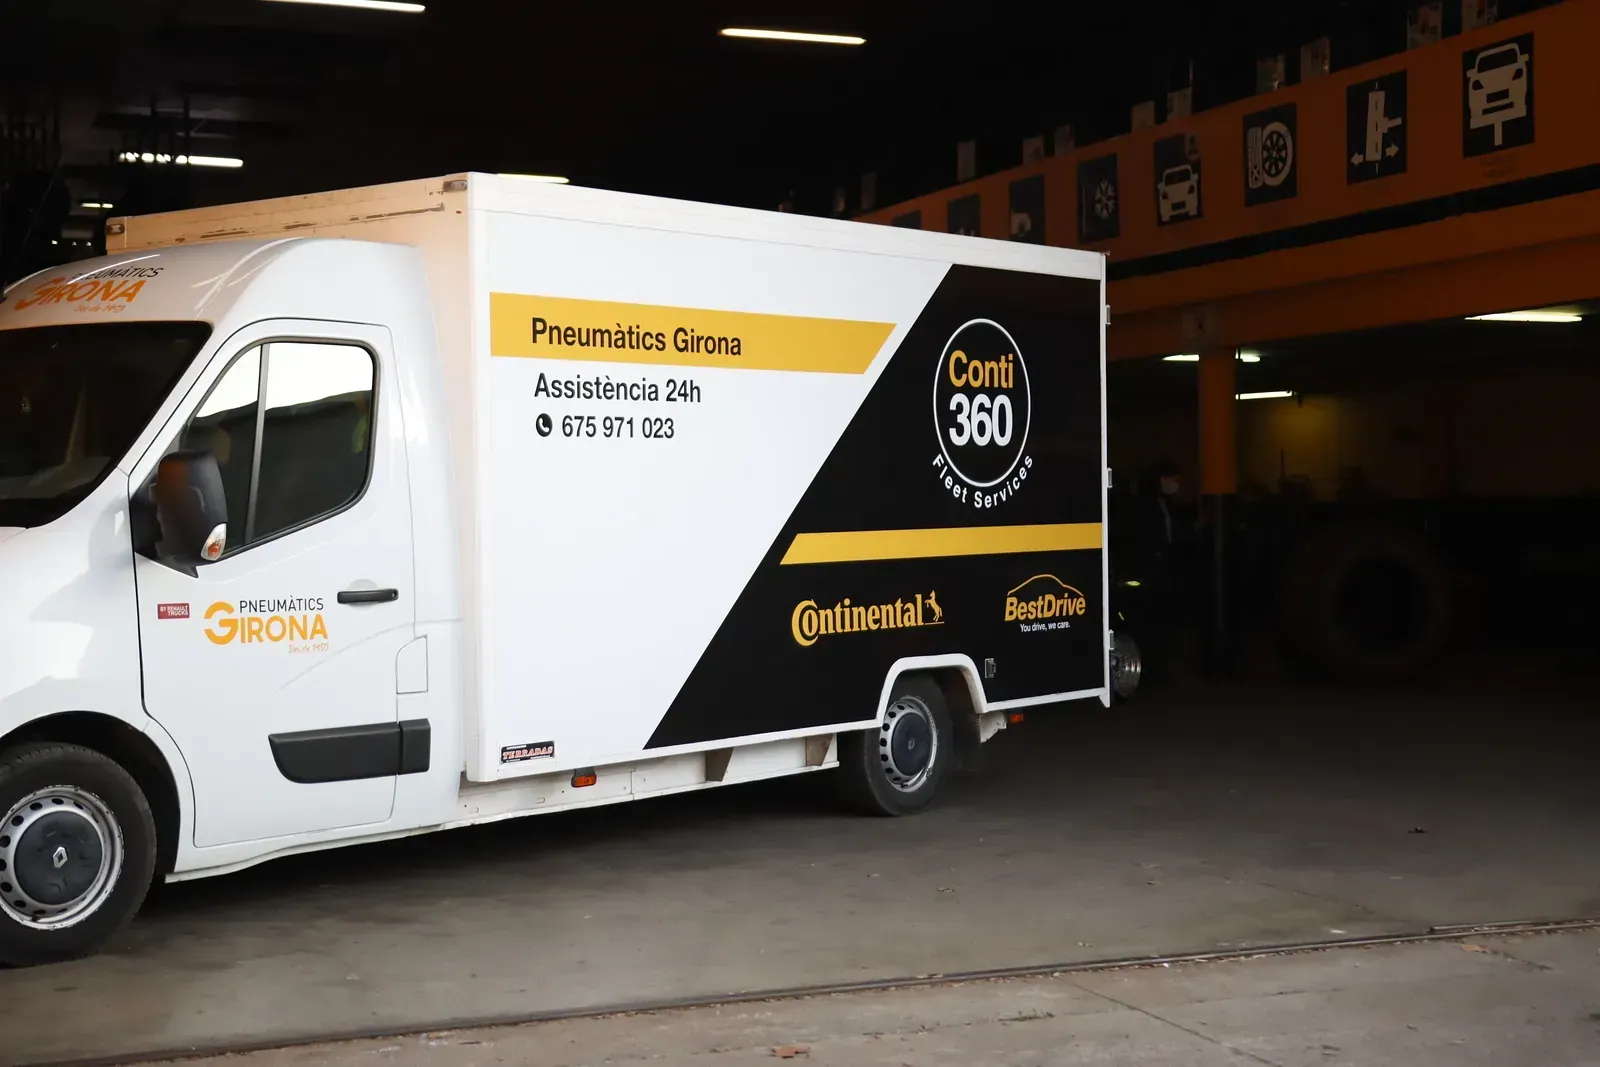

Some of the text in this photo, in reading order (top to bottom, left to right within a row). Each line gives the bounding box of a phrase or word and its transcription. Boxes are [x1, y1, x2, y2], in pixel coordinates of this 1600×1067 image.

[14, 276, 147, 310] GIRONA
[532, 317, 742, 356] Pneumàtics Girona
[949, 350, 1014, 388] Conti
[534, 372, 701, 403] Assistència 24h
[561, 415, 675, 439] 675 971 023
[949, 393, 1014, 447] 360
[932, 453, 1033, 509] Fleet Services
[239, 595, 325, 613] PNEUMÀTICS
[791, 593, 925, 646] Continental
[1005, 592, 1086, 621] BestDrive
[203, 601, 329, 645] GIRONA
[1020, 621, 1071, 632] You drive, we care.
[503, 745, 554, 760] TERRADAS
